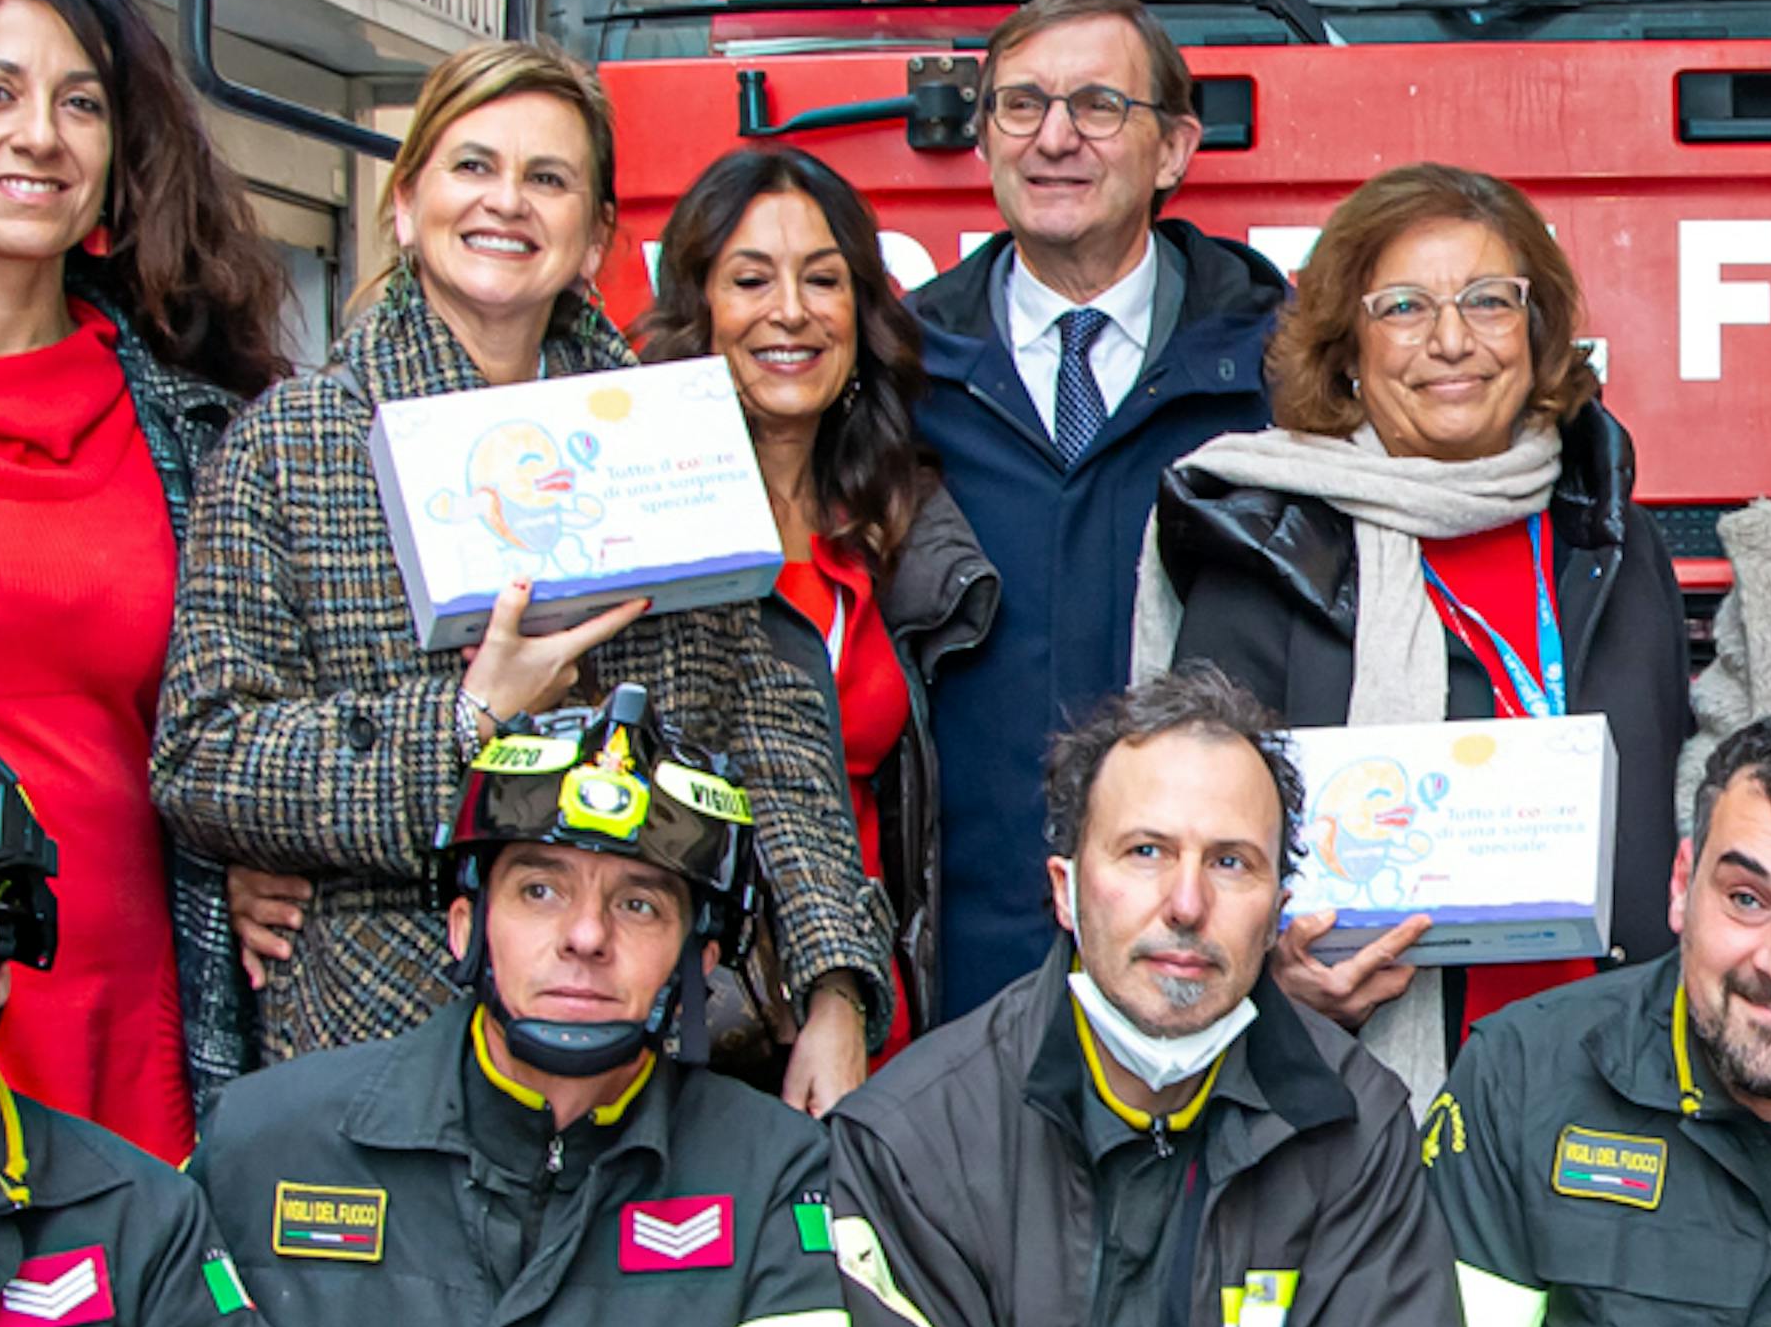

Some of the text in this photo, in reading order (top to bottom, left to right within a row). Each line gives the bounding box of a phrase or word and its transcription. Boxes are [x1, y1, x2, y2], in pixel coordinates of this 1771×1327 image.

[606, 463, 656, 482] Tutto
[602, 468, 748, 500] di una sorpresa
[639, 493, 715, 514] speciale
[1449, 806, 1493, 822] Tutto
[1435, 821, 1587, 843] di una sorpresa
[1468, 837, 1552, 857] speciale
[1566, 1141, 1659, 1175] VIGILI DEL FUOCO
[282, 1199, 377, 1227] VIGILI DEL FUOCO
